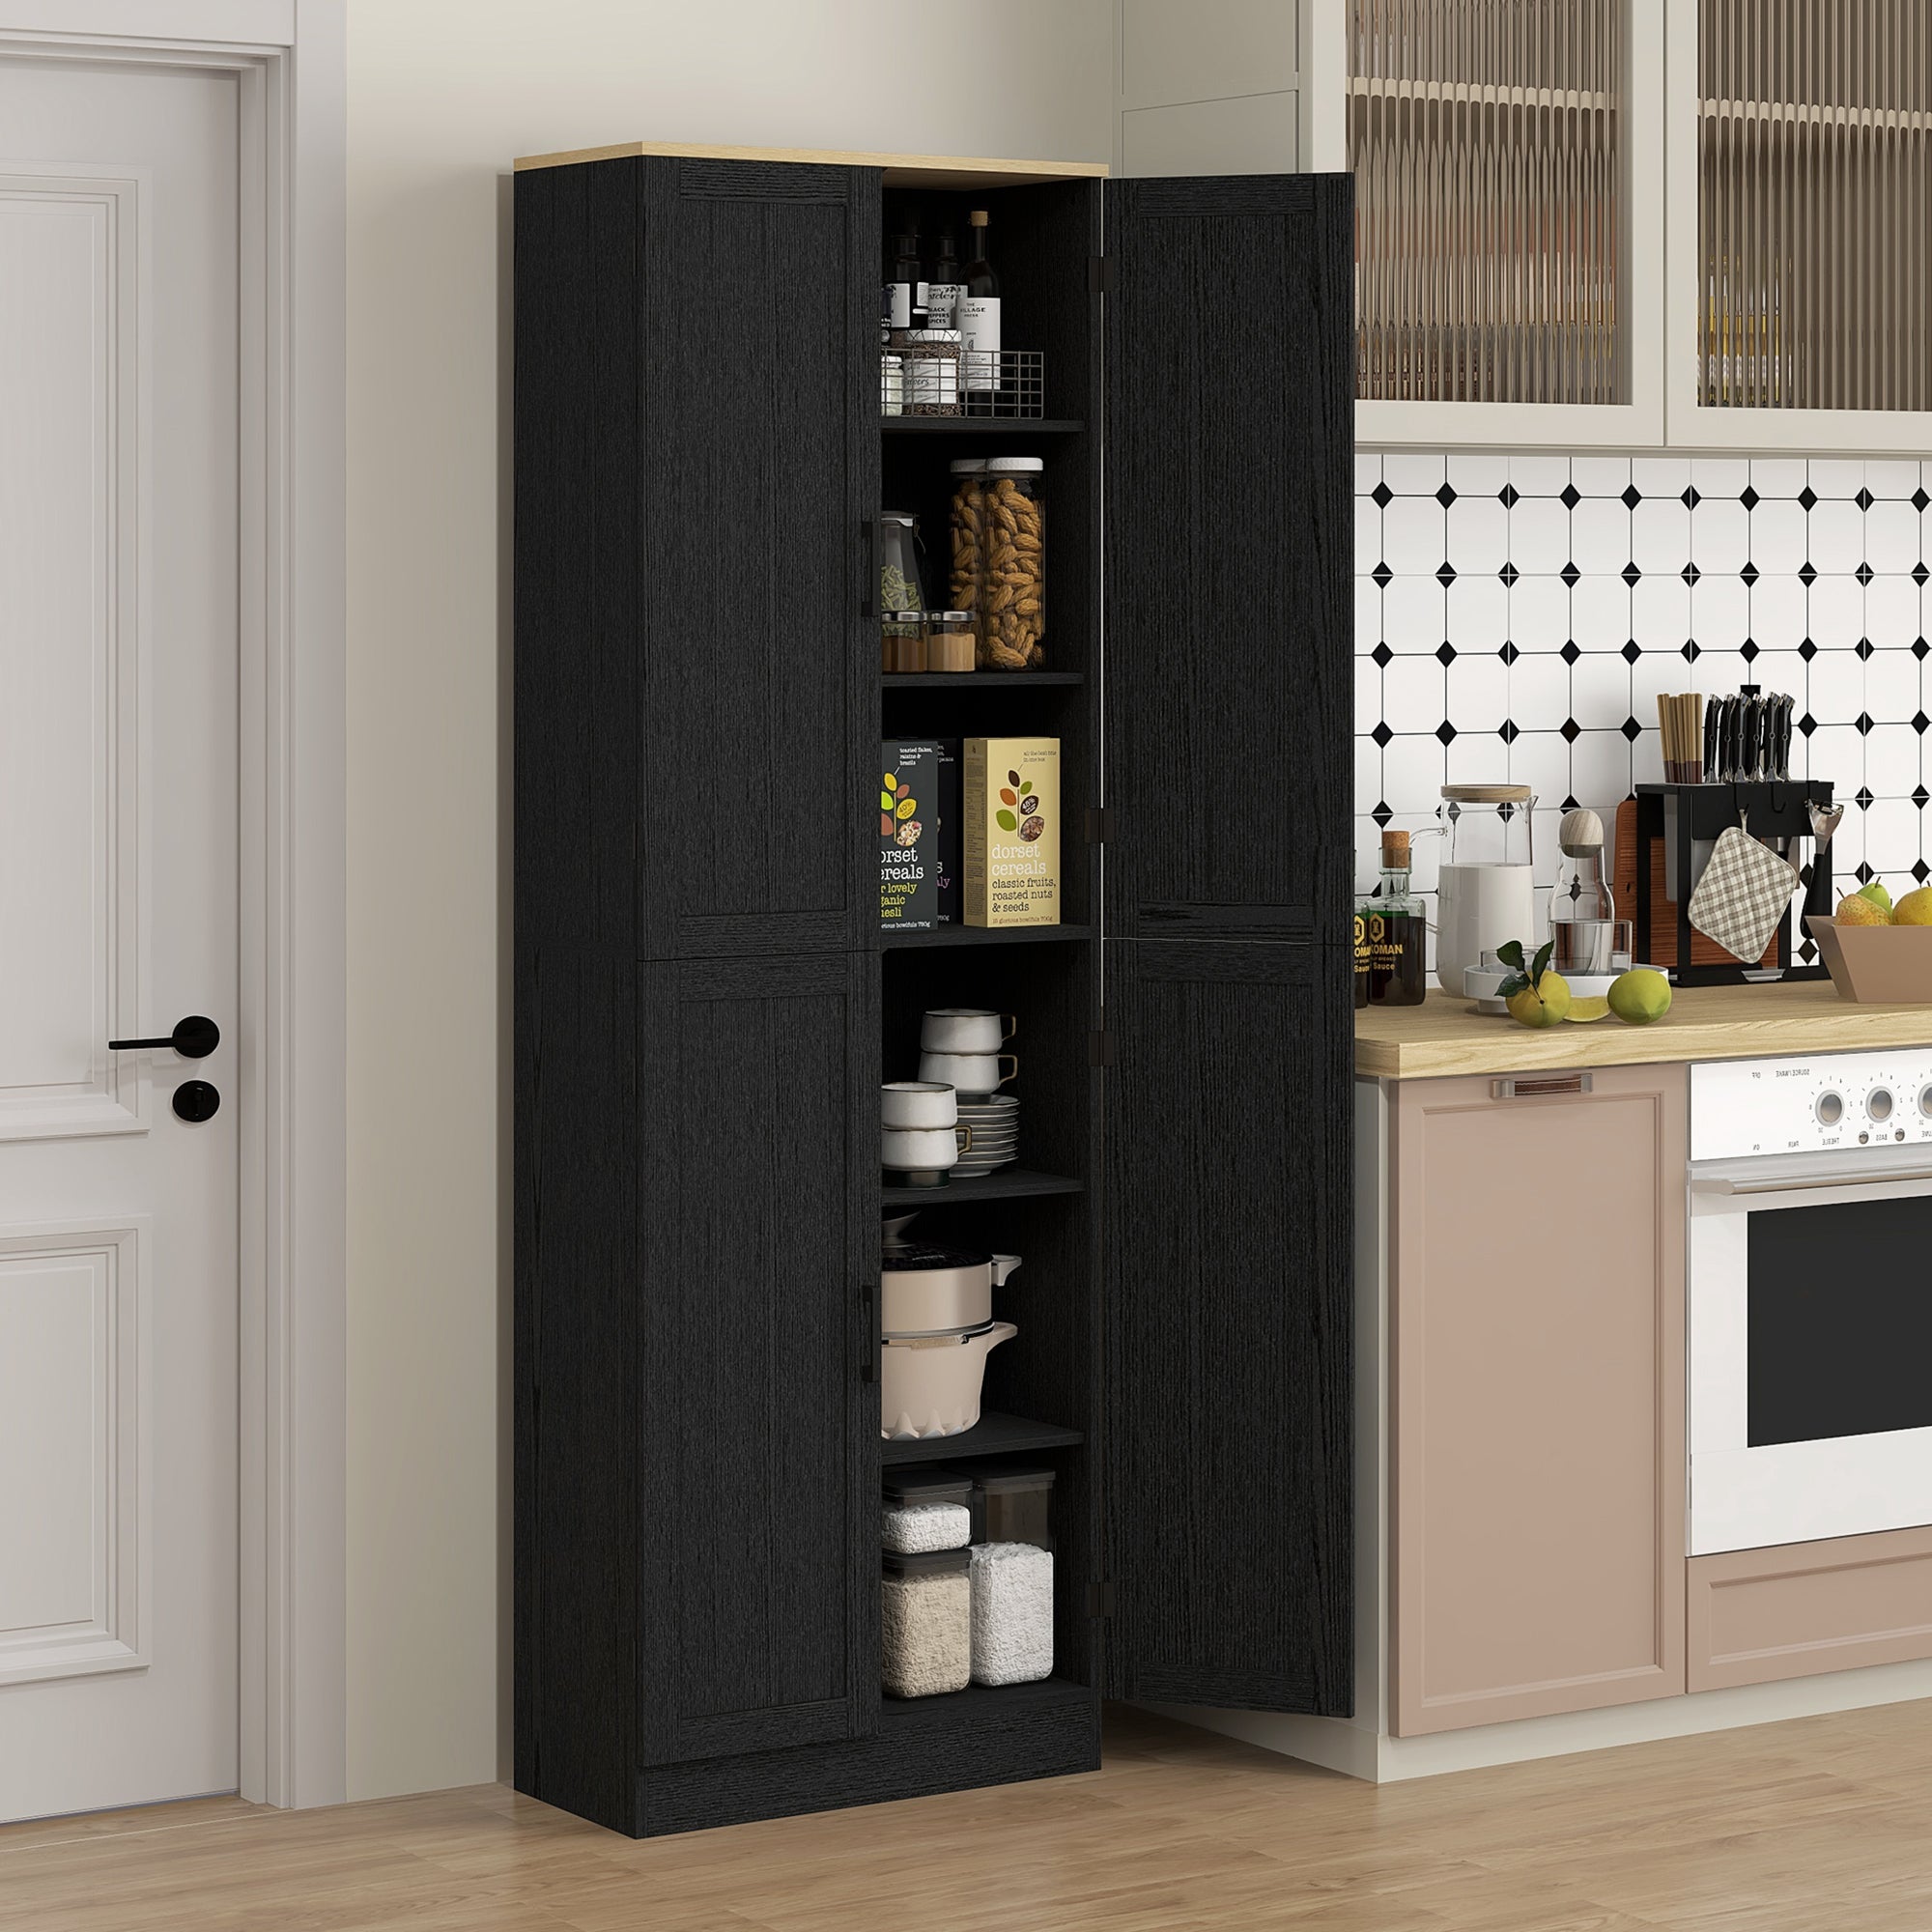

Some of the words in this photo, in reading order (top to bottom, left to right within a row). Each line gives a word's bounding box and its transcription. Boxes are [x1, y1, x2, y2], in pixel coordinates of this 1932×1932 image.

[991, 842, 1041, 860] dorset
[991, 860, 1047, 876] cereals
[888, 882, 917, 895] lovely
[992, 878, 1025, 889] classic
[1027, 877, 1057, 888] fruits,
[992, 890, 1029, 901] roasted
[1031, 890, 1053, 899] nuts
[992, 903, 1001, 913] &
[1003, 902, 1030, 912] seeds
[1373, 962, 1396, 971] Sauce
